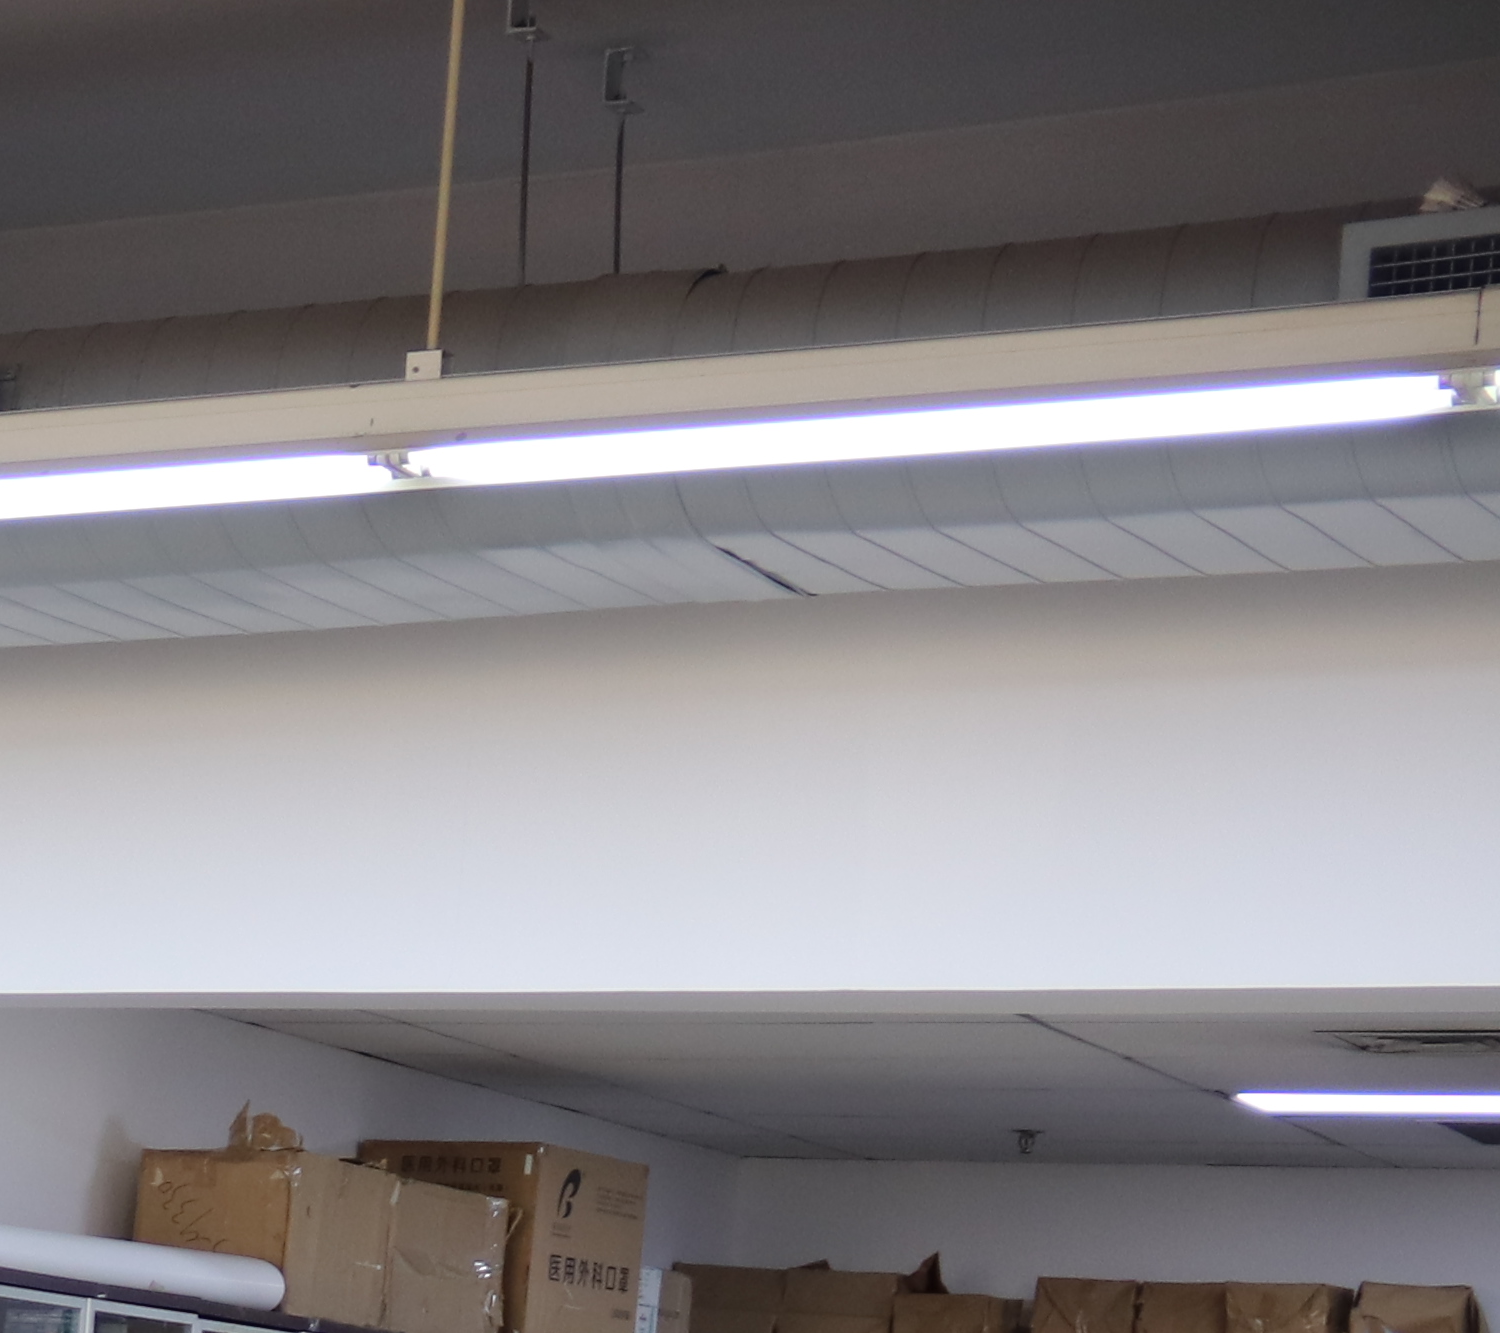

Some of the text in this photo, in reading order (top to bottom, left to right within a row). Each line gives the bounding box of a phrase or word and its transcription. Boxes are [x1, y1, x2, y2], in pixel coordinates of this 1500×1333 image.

[549, 1255, 630, 1293] 医用外科口罩
